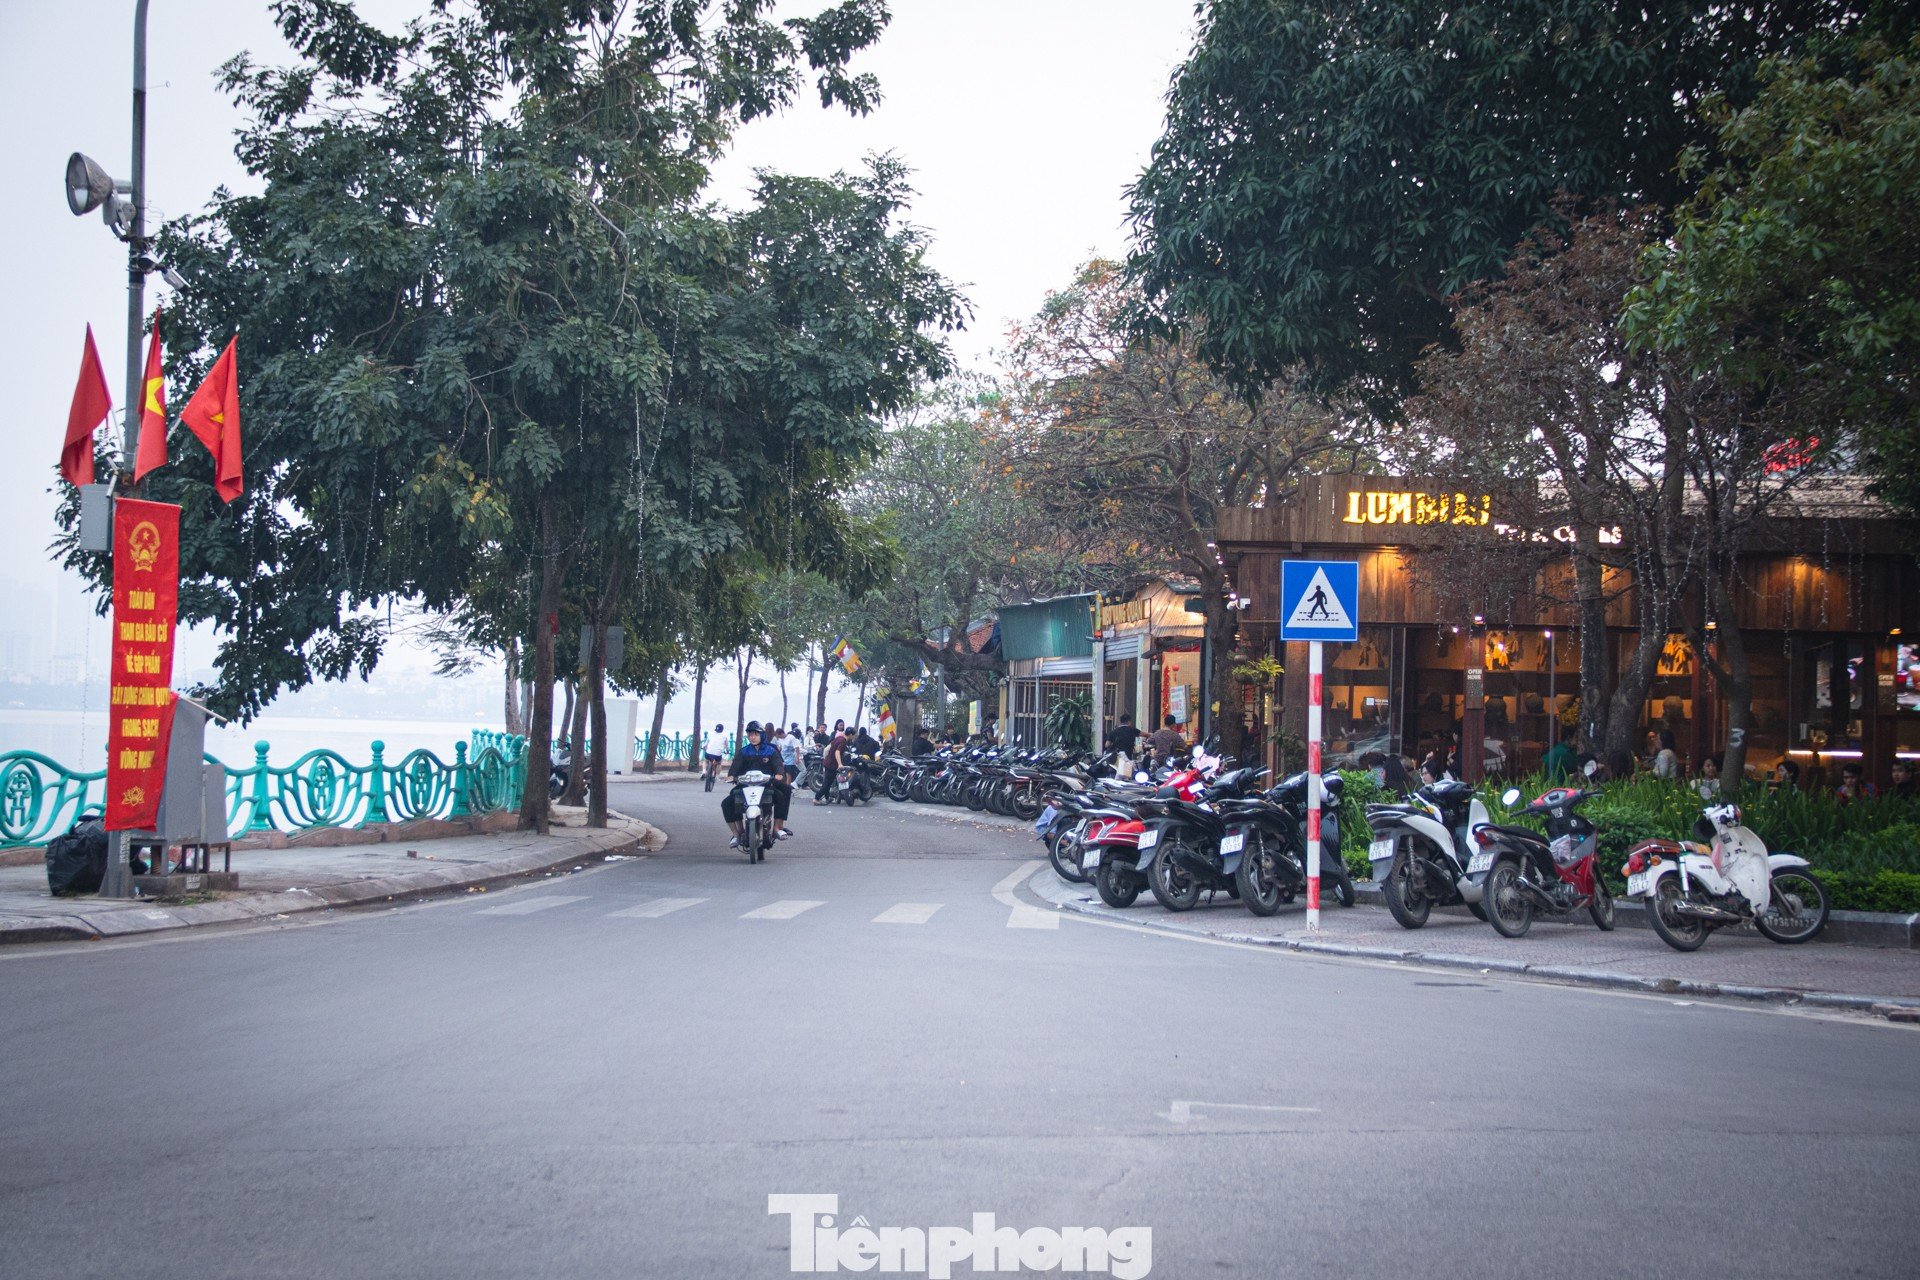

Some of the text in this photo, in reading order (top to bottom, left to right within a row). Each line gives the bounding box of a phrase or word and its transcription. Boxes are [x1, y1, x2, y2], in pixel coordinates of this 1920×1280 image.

[129, 587, 144, 609] TOÀN
[120, 622, 135, 641] THAM
[135, 622, 145, 641] GIA
[122, 718, 141, 737] TRONG
